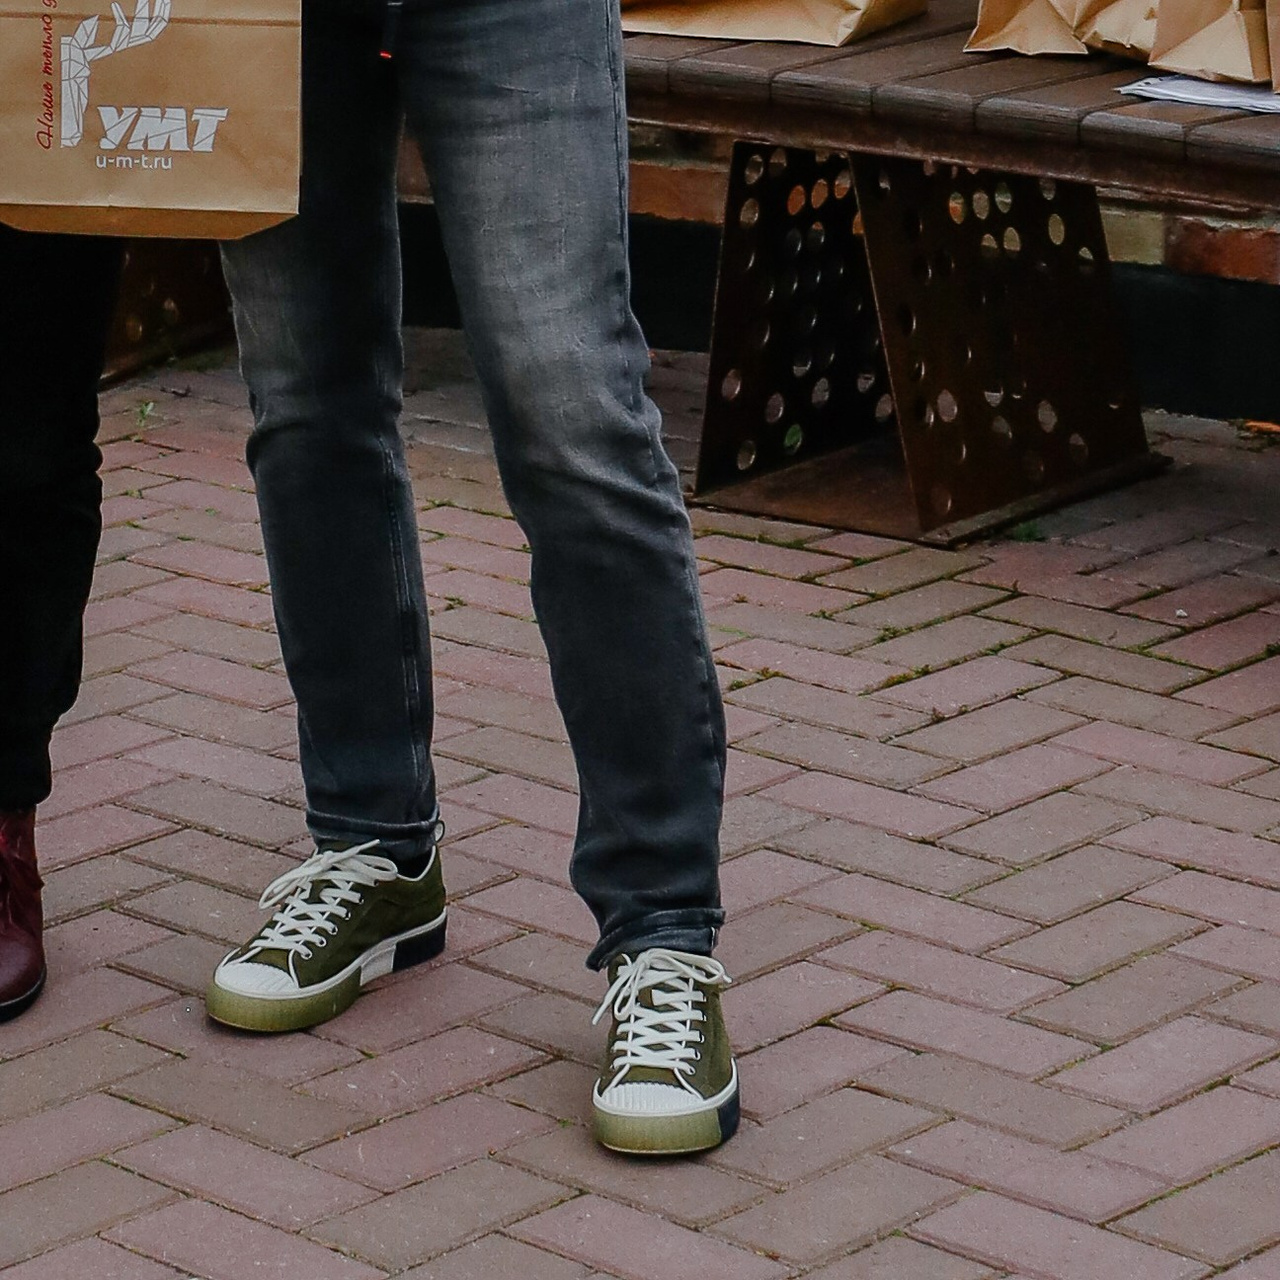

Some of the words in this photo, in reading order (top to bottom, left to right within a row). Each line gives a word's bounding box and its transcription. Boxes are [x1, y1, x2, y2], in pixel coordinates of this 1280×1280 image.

[42, 13, 53, 76] тепло
[36, 81, 54, 150] Наше
[97, 106, 229, 152] УМТ
[96, 154, 173, 170] u-m-t.ru
